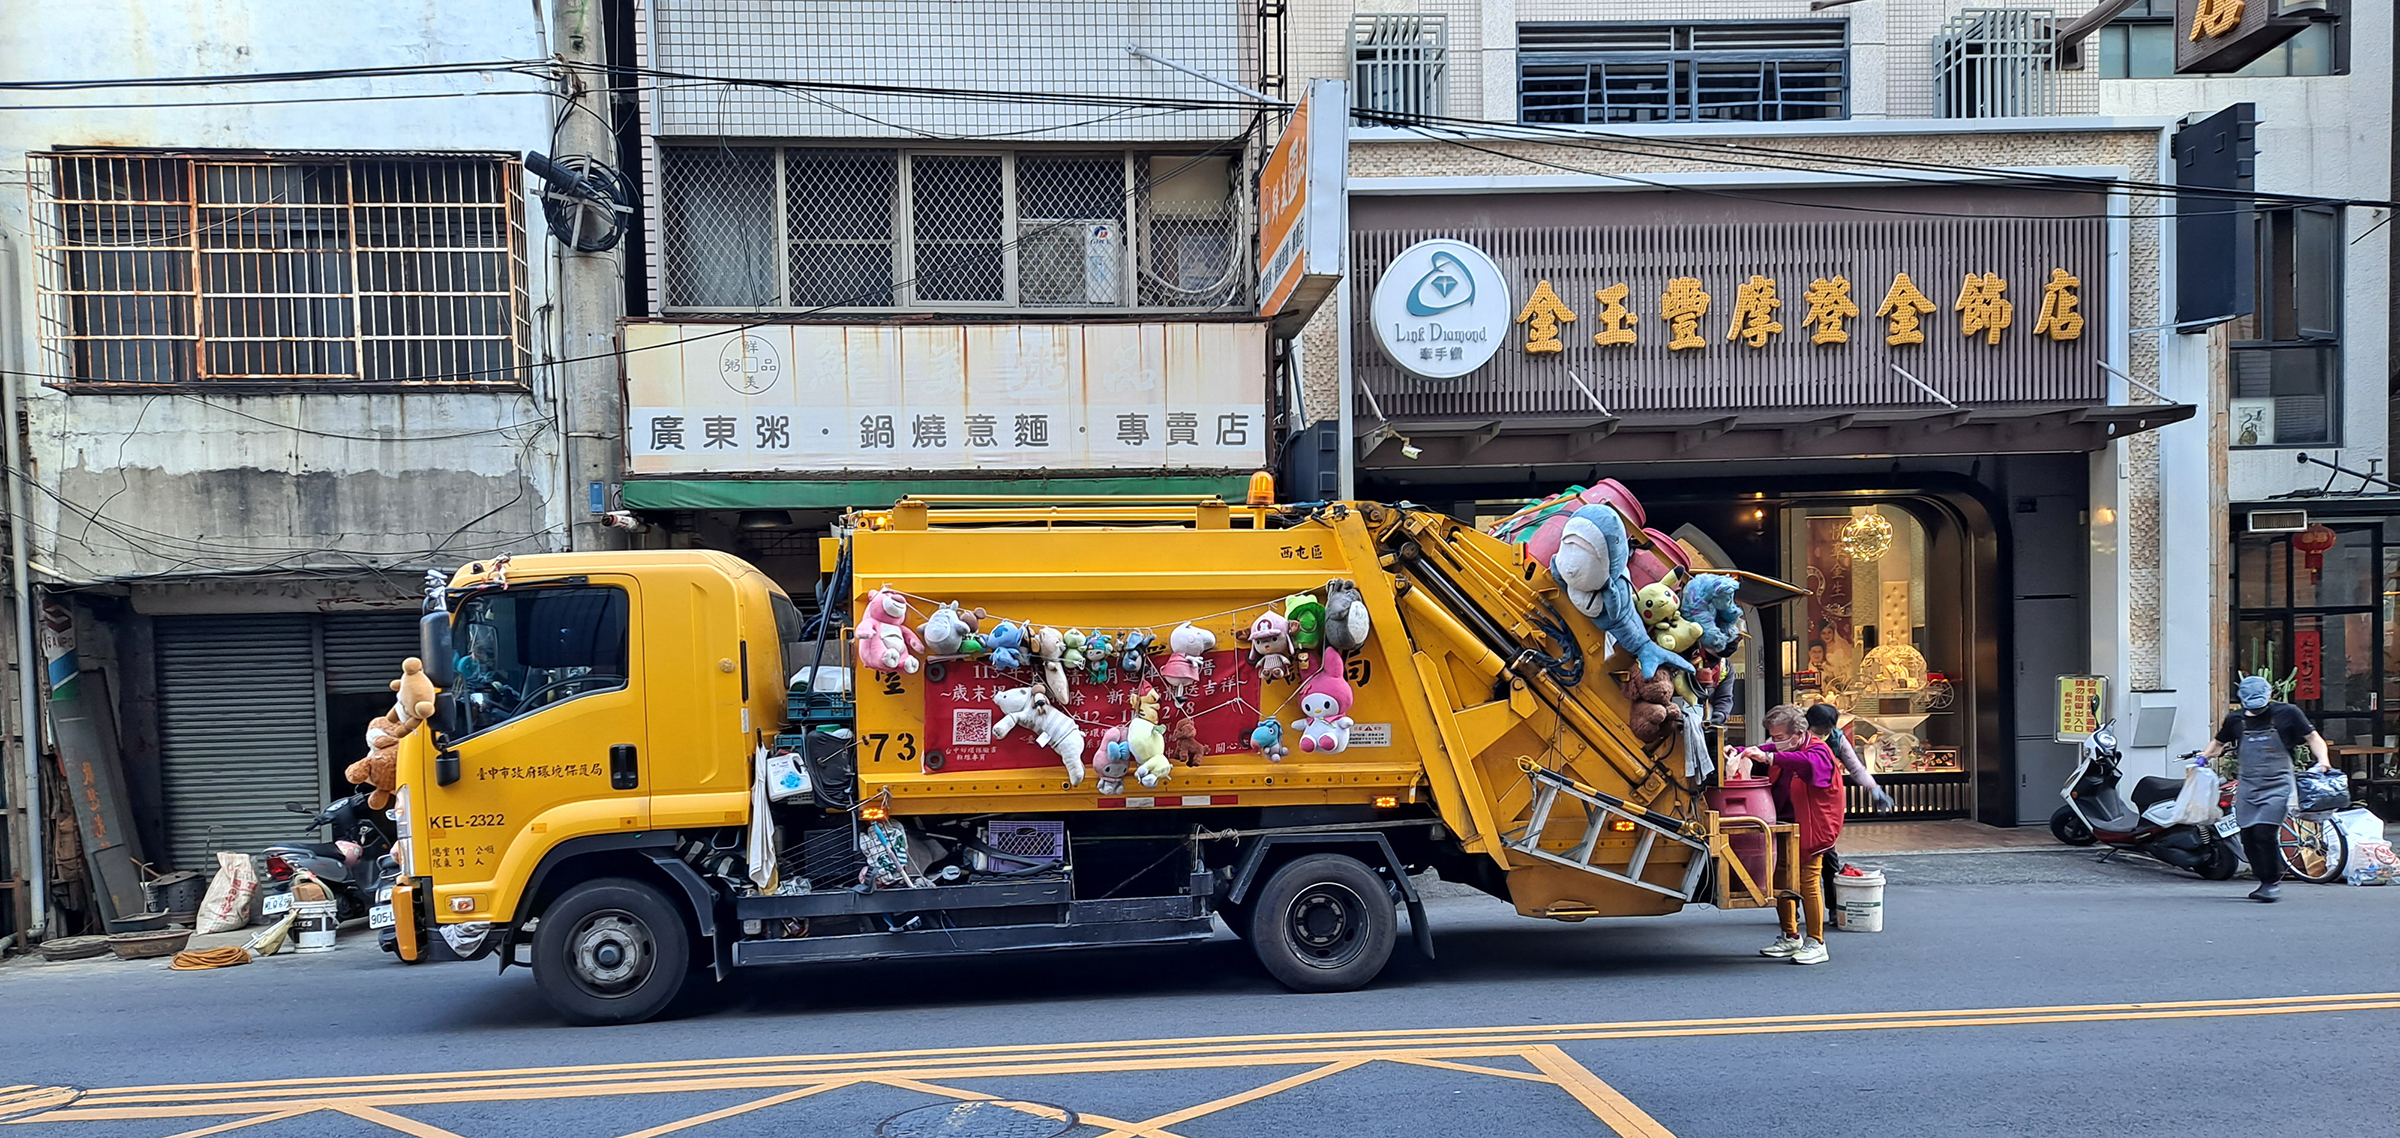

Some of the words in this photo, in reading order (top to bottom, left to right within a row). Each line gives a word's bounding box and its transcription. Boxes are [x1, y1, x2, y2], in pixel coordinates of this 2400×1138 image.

[1516, 267, 2082, 354] 金玉豐摩登金飾店
[743, 340, 759, 354] 鮮
[723, 358, 741, 373] 粥
[760, 358, 777, 371] 品
[743, 375, 760, 389] 美
[1280, 544, 1323, 560] 西屯區
[429, 813, 506, 830] KEL-2322
[454, 847, 466, 856] 11
[458, 858, 466, 868] 3
[475, 858, 485, 867] 人
